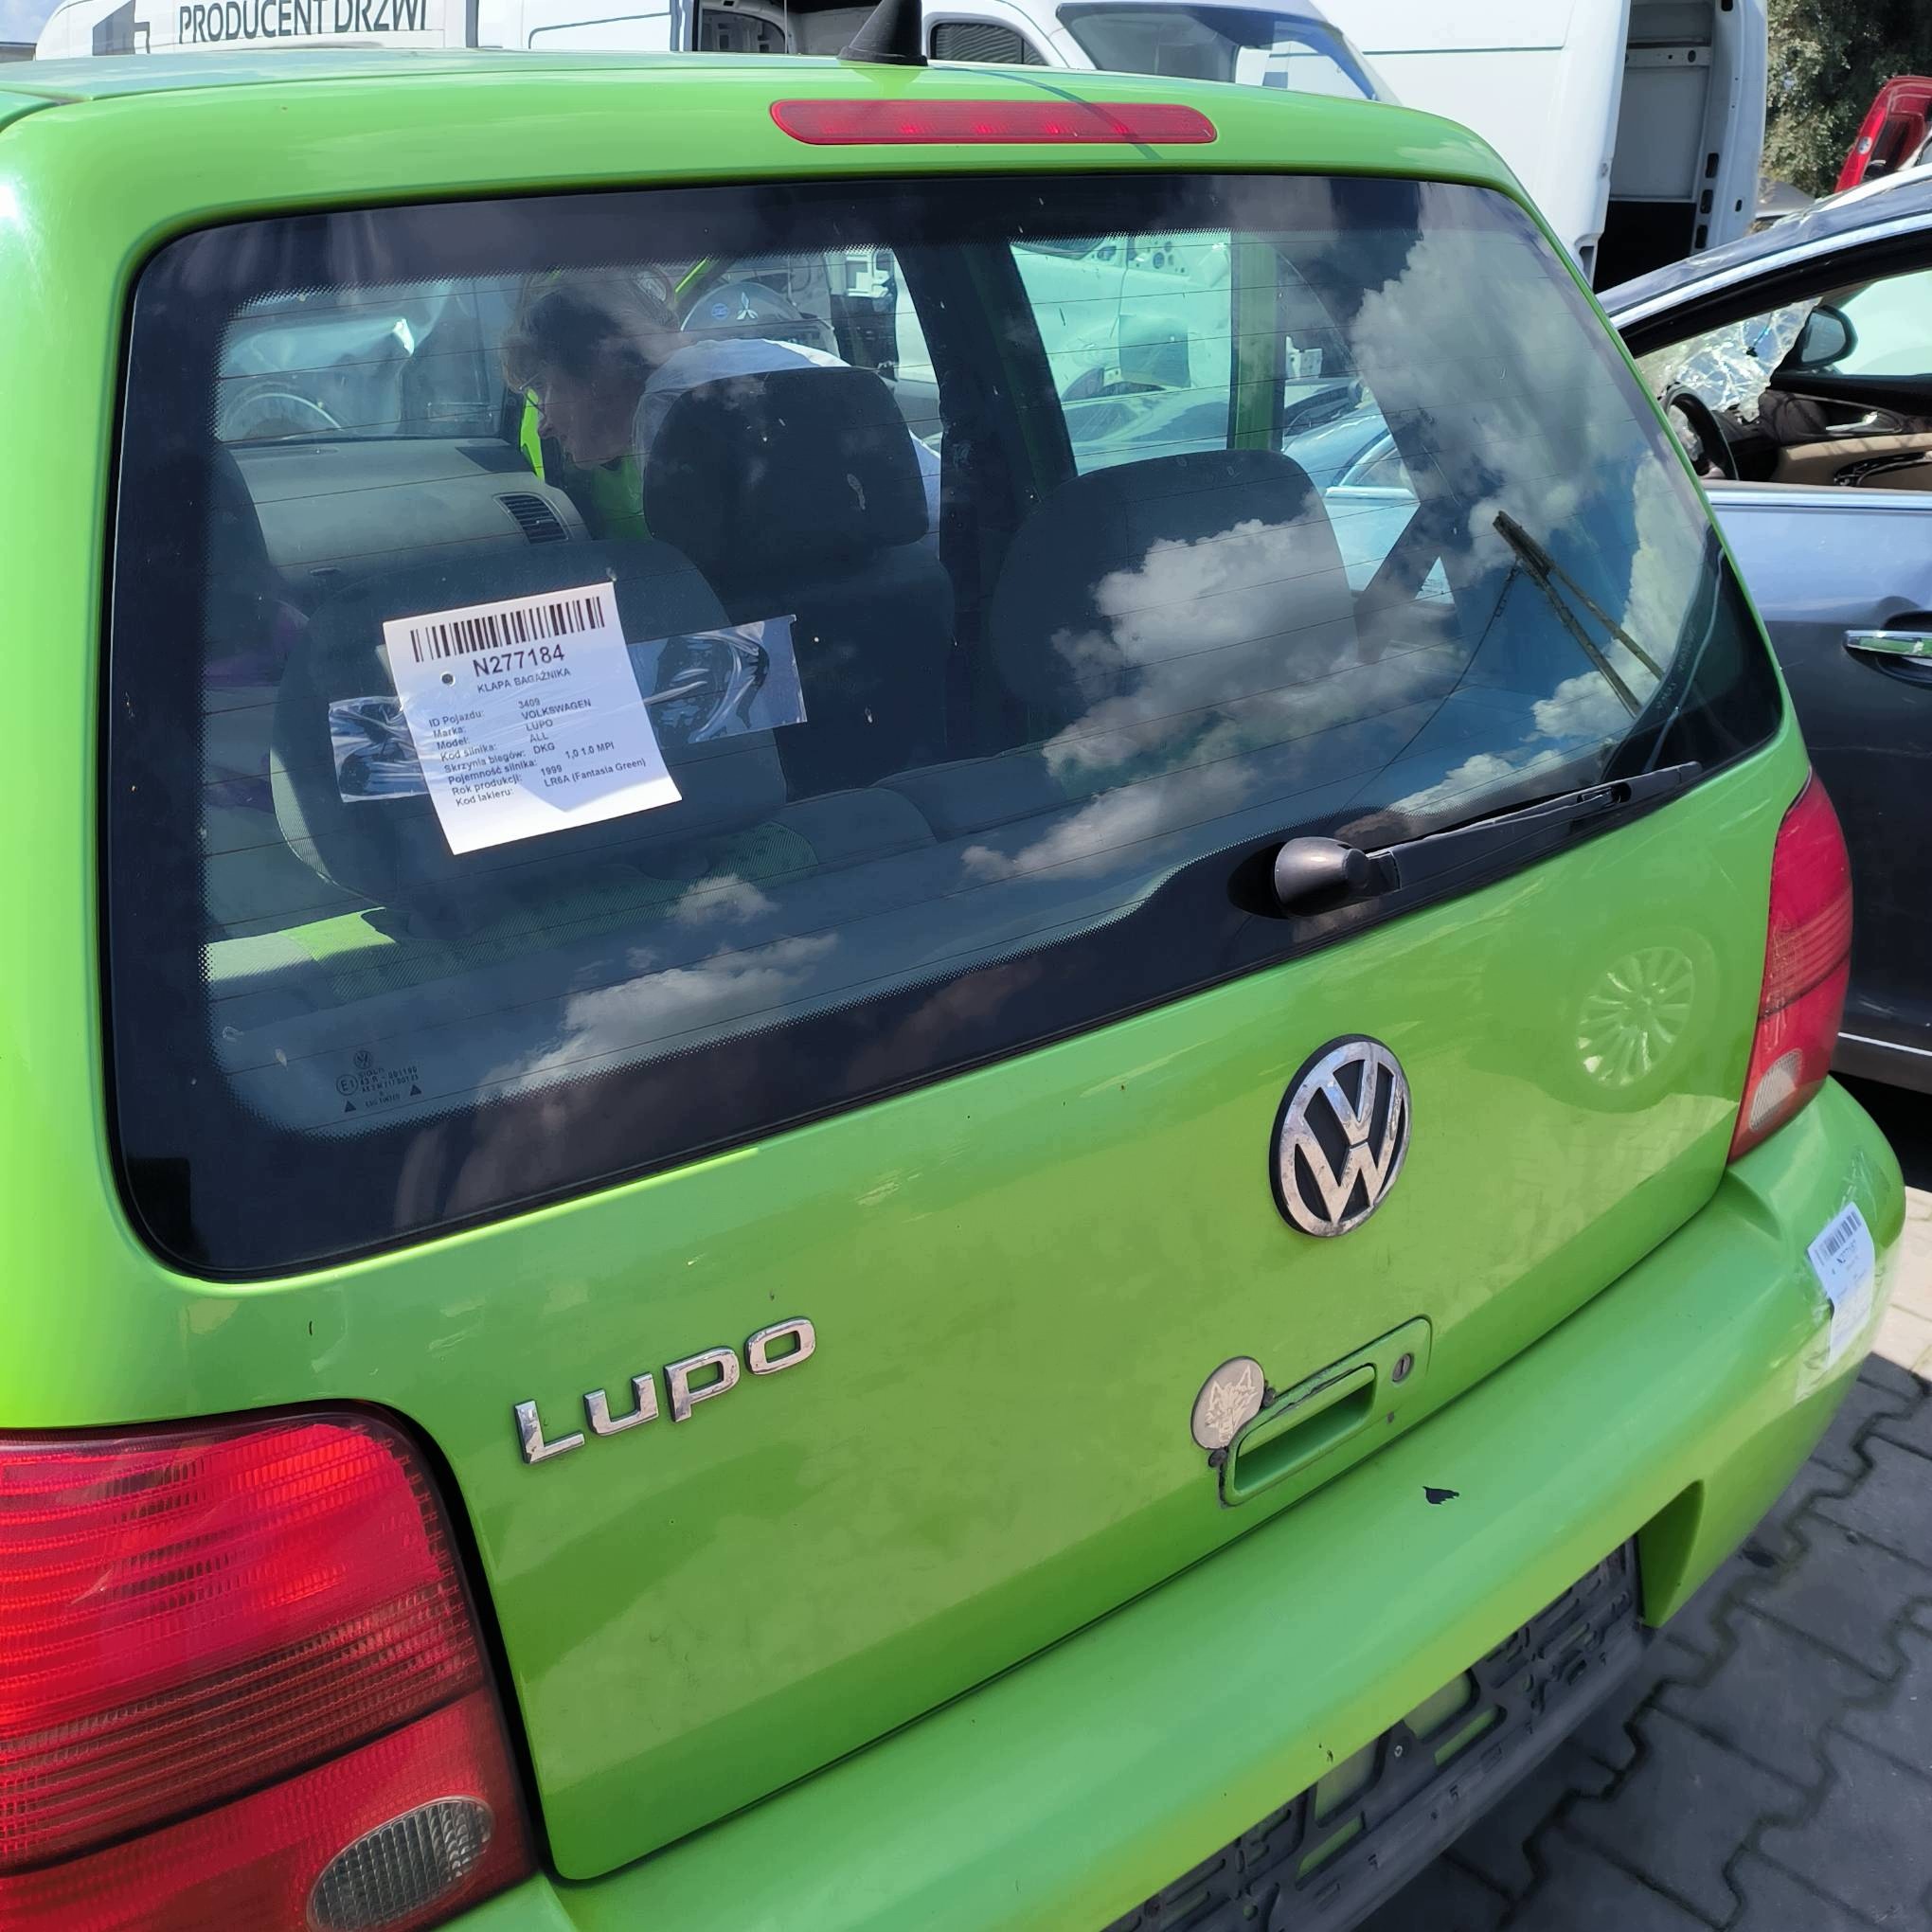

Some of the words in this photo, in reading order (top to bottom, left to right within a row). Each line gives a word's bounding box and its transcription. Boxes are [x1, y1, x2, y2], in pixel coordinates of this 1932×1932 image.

[179, 0, 329, 44] PRODUCENT
[334, 0, 426, 32] DRZWI
[473, 644, 564, 677] N277184
[477, 679, 512, 694] KLAPA
[514, 667, 571, 687] BAGAŻNIKA
[429, 718, 440, 727] ID
[442, 709, 485, 725] Pojazdu:
[518, 697, 541, 709] 3409
[433, 725, 466, 739] Marka:
[521, 698, 592, 720] VOLKSWAGEN
[437, 736, 470, 750] Model:
[526, 720, 553, 732] LUPO
[440, 750, 461, 762] Kod
[464, 742, 498, 758] silnika:
[529, 732, 549, 743] ALL
[443, 758, 487, 774] Skrzynia
[488, 750, 526, 765] biegów:
[532, 742, 556, 755] DKG
[448, 766, 502, 785] Pojemność
[504, 759, 538, 773] silnika:
[596, 742, 615, 753] MPI
[452, 784, 473, 796] Rok
[474, 774, 522, 793] produkcji:
[541, 764, 563, 777] 1999
[456, 796, 476, 808] Kod
[478, 787, 514, 802] lakieru:
[544, 775, 571, 788] LR6A
[572, 766, 614, 783] (Fantasia
[615, 758, 647, 772] Green)
